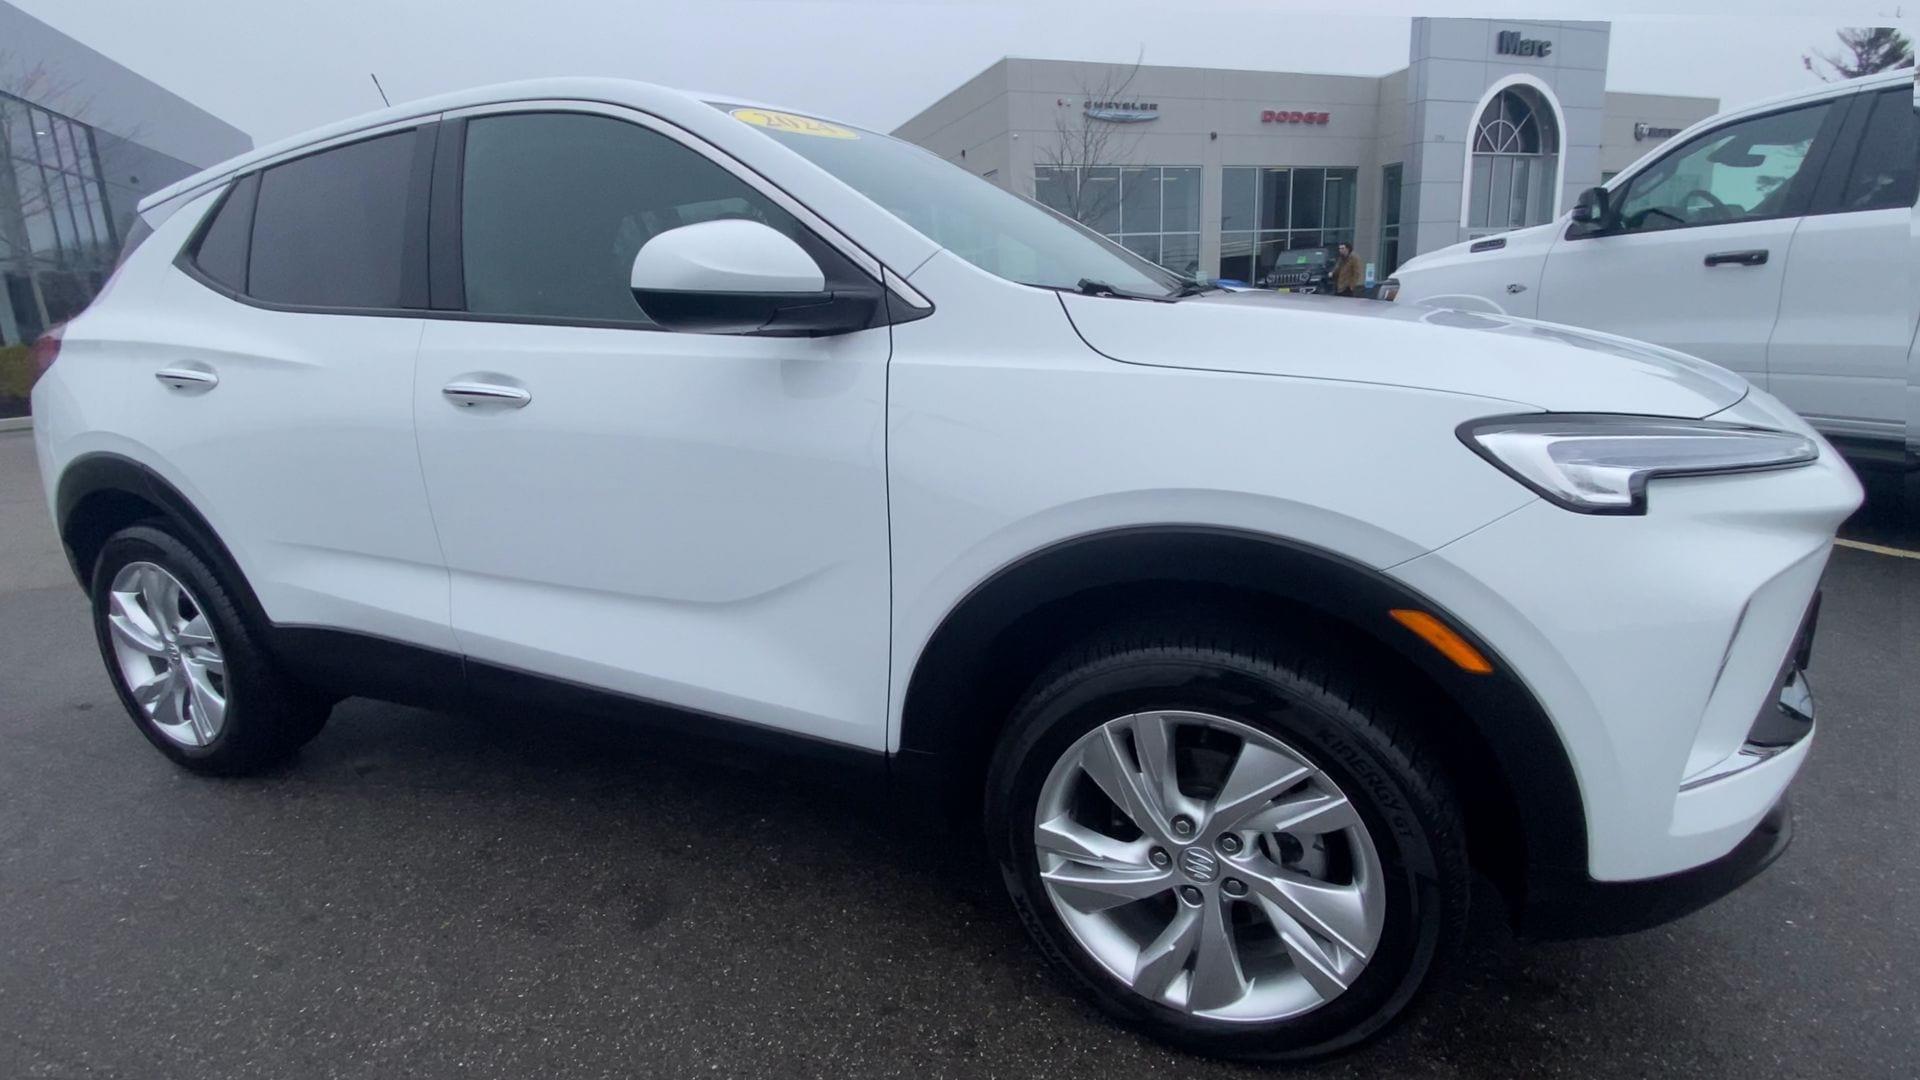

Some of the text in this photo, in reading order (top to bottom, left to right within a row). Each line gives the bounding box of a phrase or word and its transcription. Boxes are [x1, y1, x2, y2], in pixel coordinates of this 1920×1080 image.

[1498, 30, 1552, 57] Marc
[1084, 101, 1159, 111] CHRYSLER
[1261, 110, 1330, 125] DODGE
